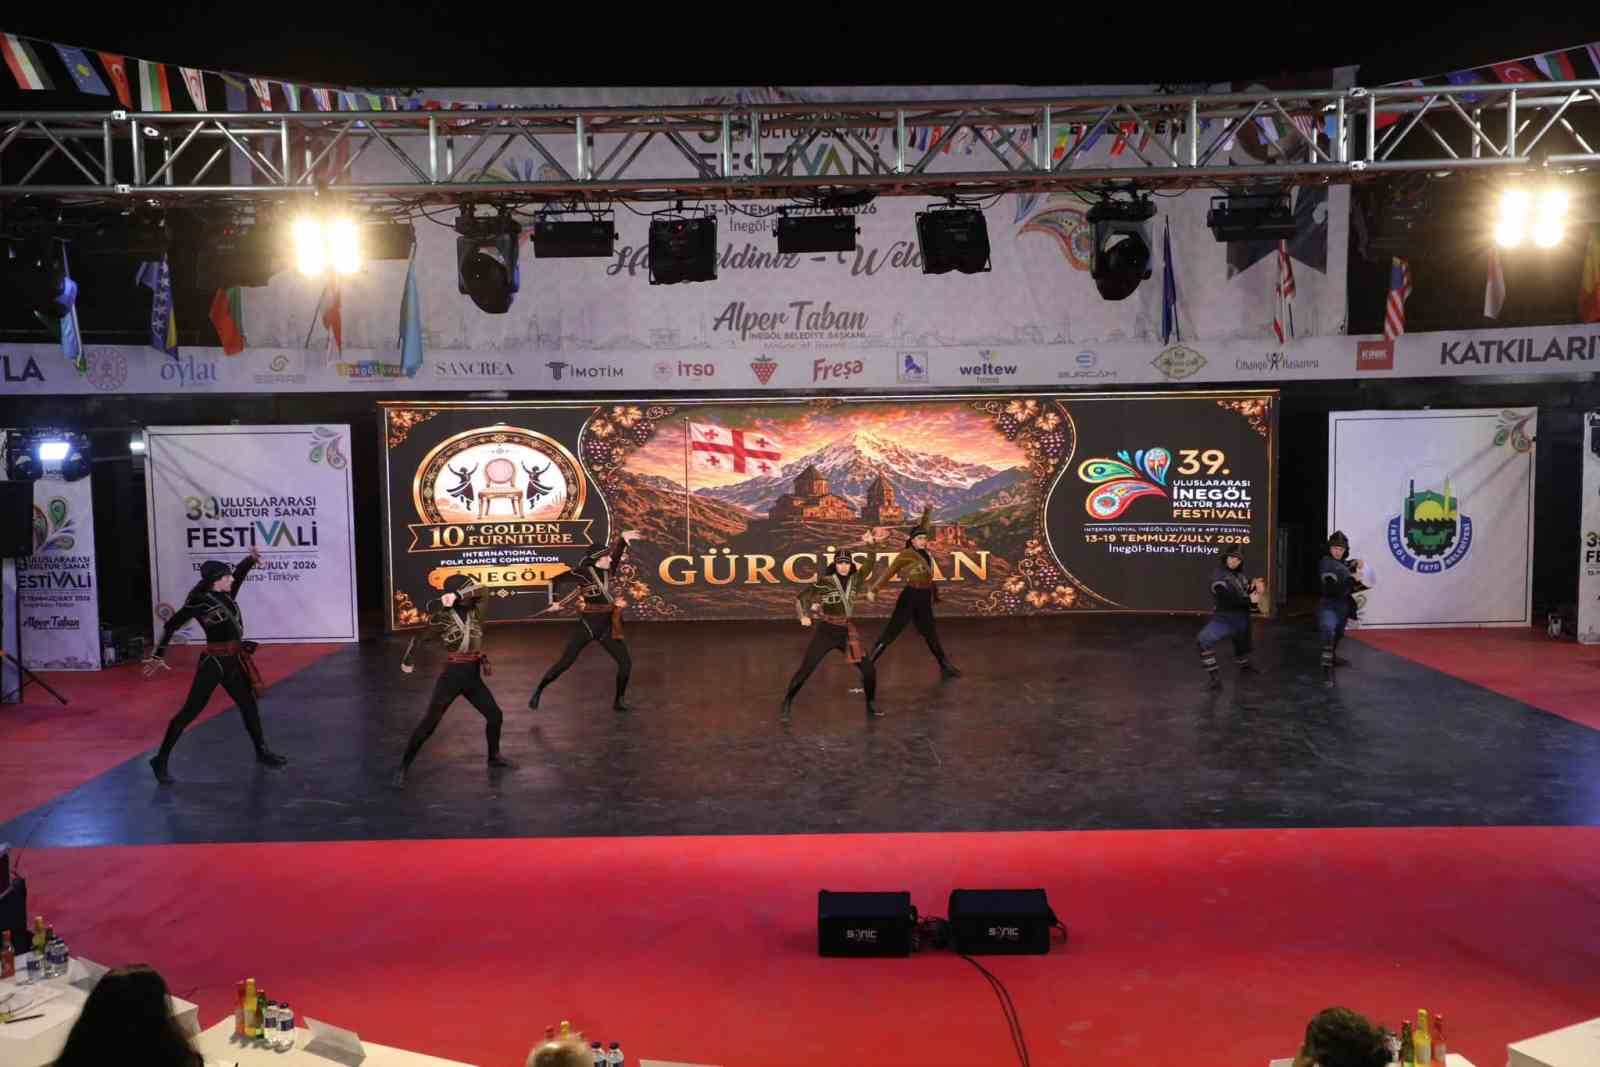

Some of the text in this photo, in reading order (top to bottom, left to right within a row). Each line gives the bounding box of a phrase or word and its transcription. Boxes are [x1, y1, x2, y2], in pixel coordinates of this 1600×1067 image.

[712, 301, 869, 341] Alper Taban
[1441, 336, 1600, 365] KATKILARI
[812, 357, 864, 383] Freşa
[1176, 449, 1231, 476] 39.
[1173, 479, 1251, 487] ULUSLARARASI
[1173, 487, 1252, 501] İNEGÖL
[220, 496, 317, 507] ULUSLARARASI
[1215, 501, 1251, 509] SANAT
[275, 507, 316, 517] SANAT
[1173, 508, 1251, 520] FESTİVALİ
[186, 521, 319, 548] FESTİVALİ
[480, 524, 561, 535] GOLDEN
[468, 533, 574, 546] FURNITURE
[1084, 534, 1250, 544] 13-19 TEMMUZ/JULY 2026
[462, 549, 537, 557] INTERNATIONAL
[293, 561, 317, 570] 2026
[658, 547, 991, 585] GÜRCİTN
[17, 571, 92, 588] ESTİVALİ
